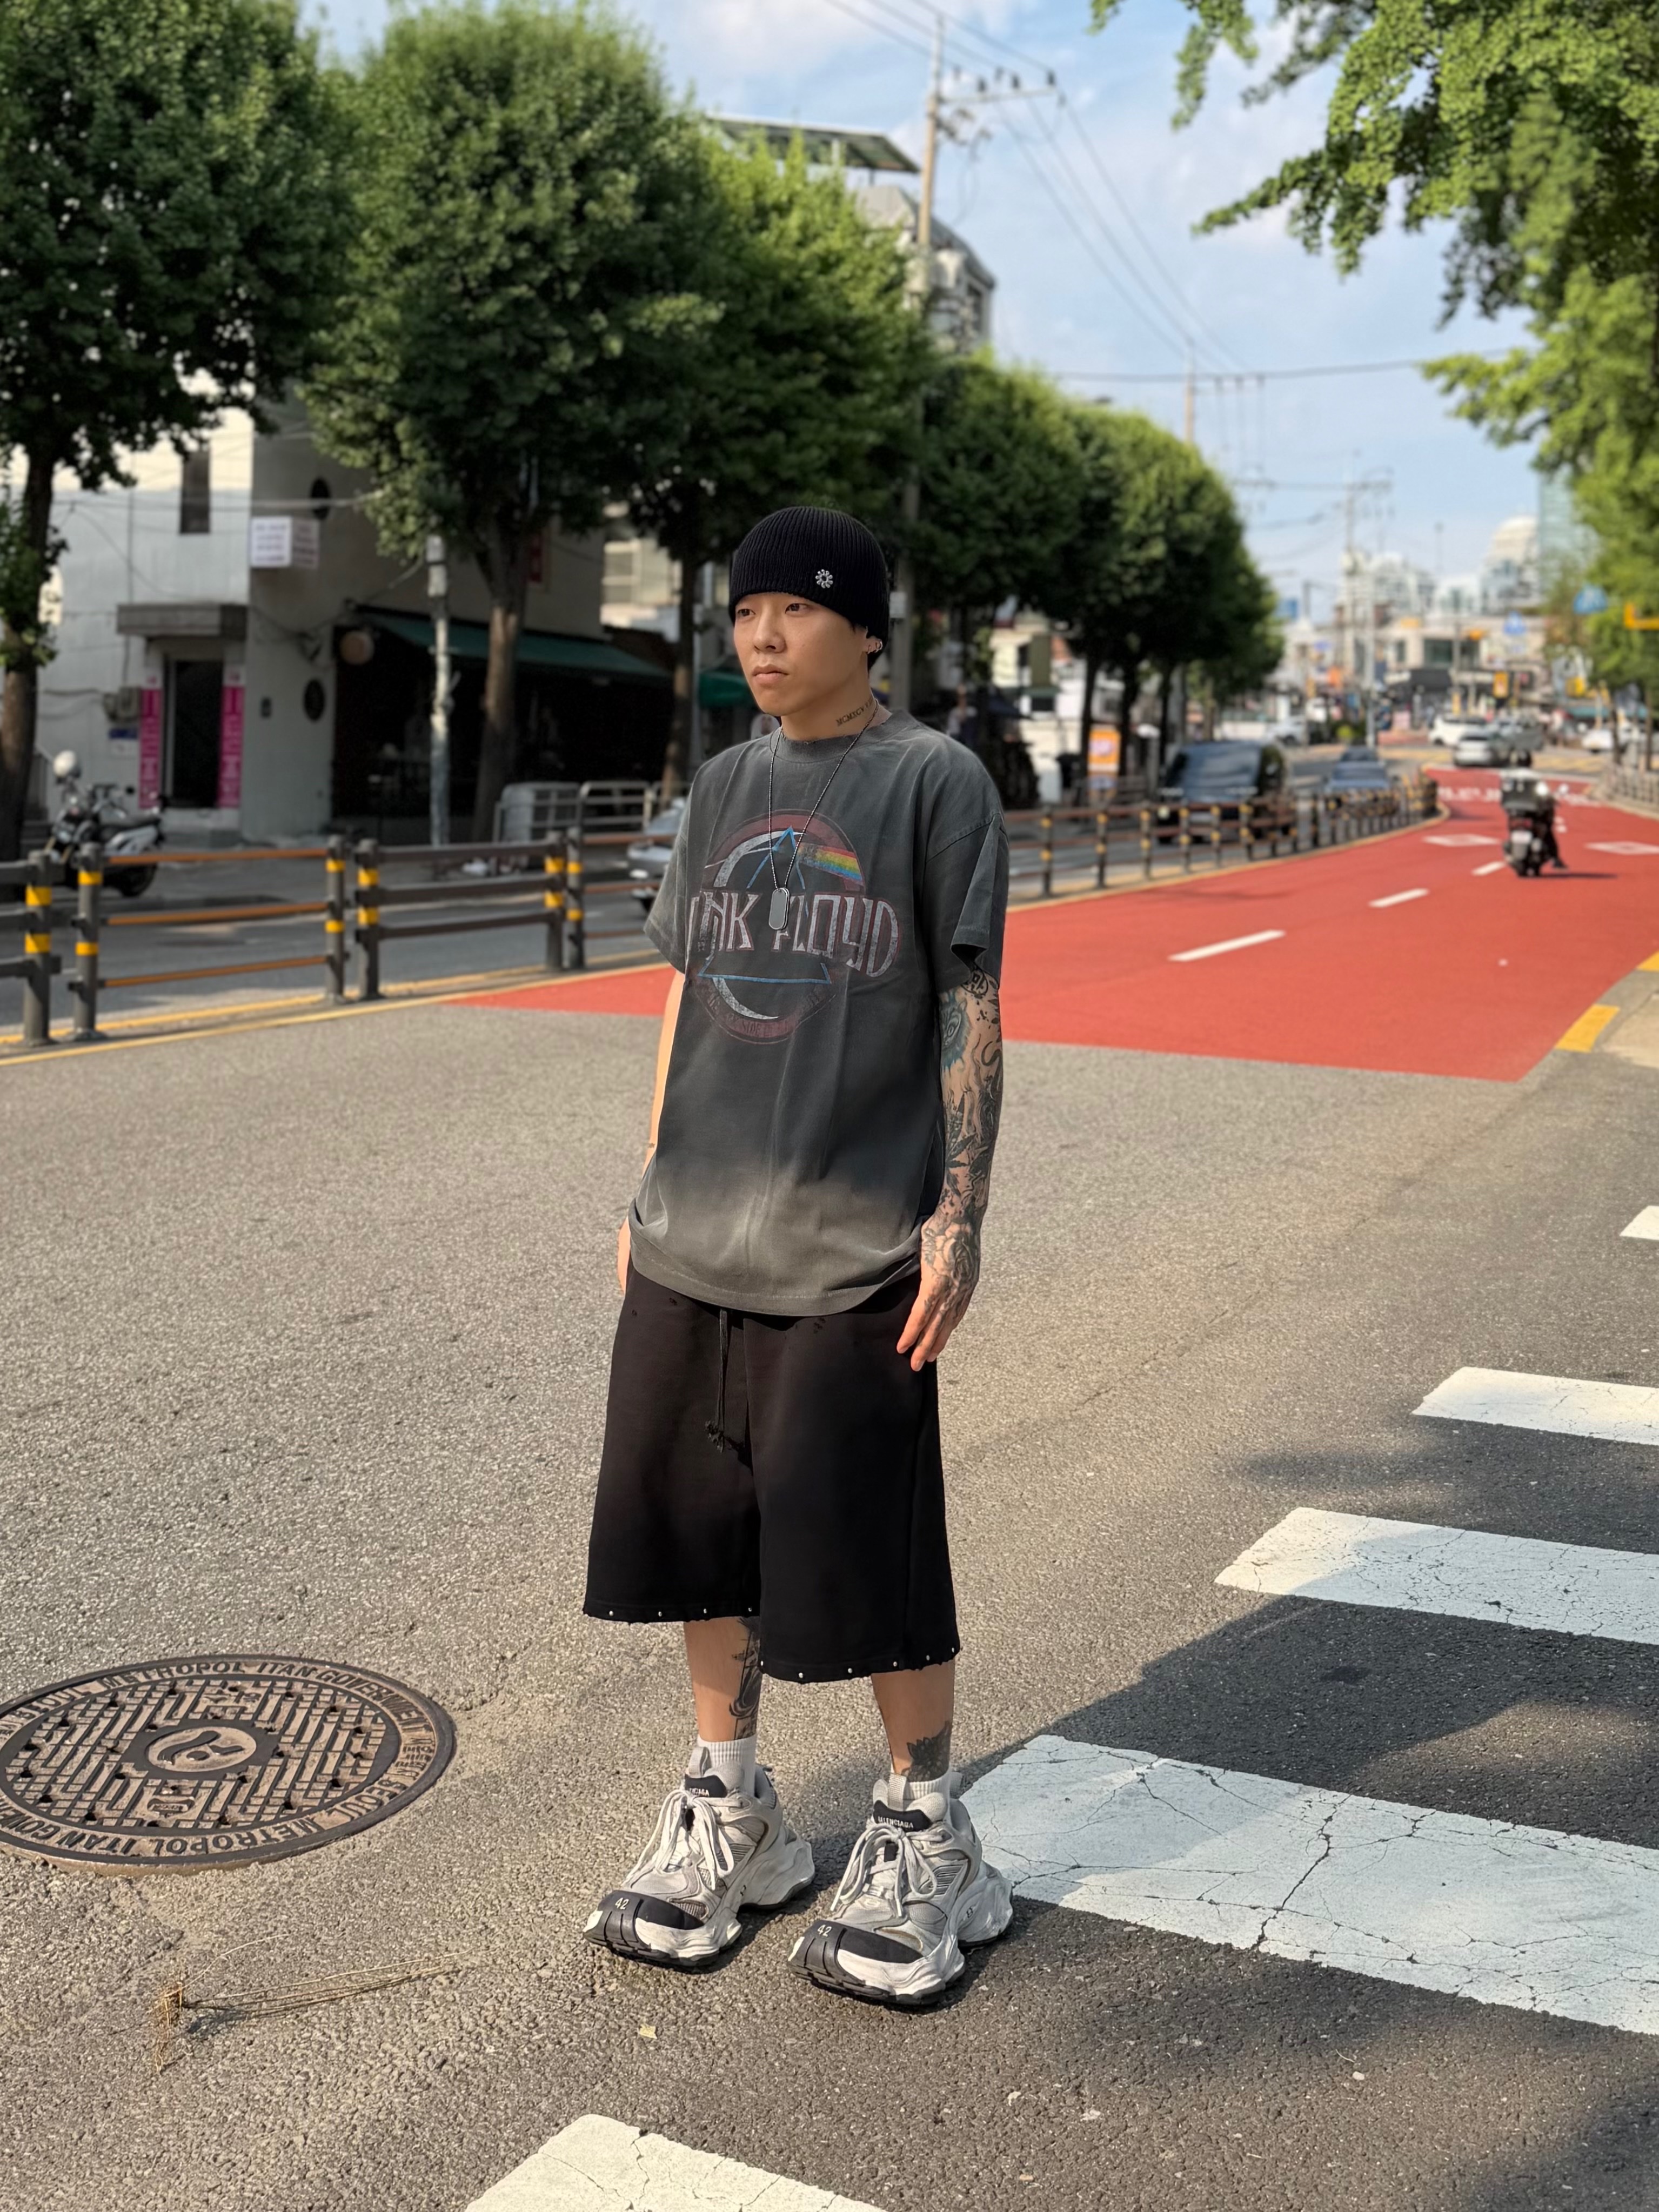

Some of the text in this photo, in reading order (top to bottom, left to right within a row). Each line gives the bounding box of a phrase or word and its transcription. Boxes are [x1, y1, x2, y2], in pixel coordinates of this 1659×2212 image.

[11, 1687, 92, 1720] SEOUL
[325, 1779, 407, 1821] SEOUL
[615, 1897, 630, 1910] 42
[817, 1924, 832, 1937] 42
